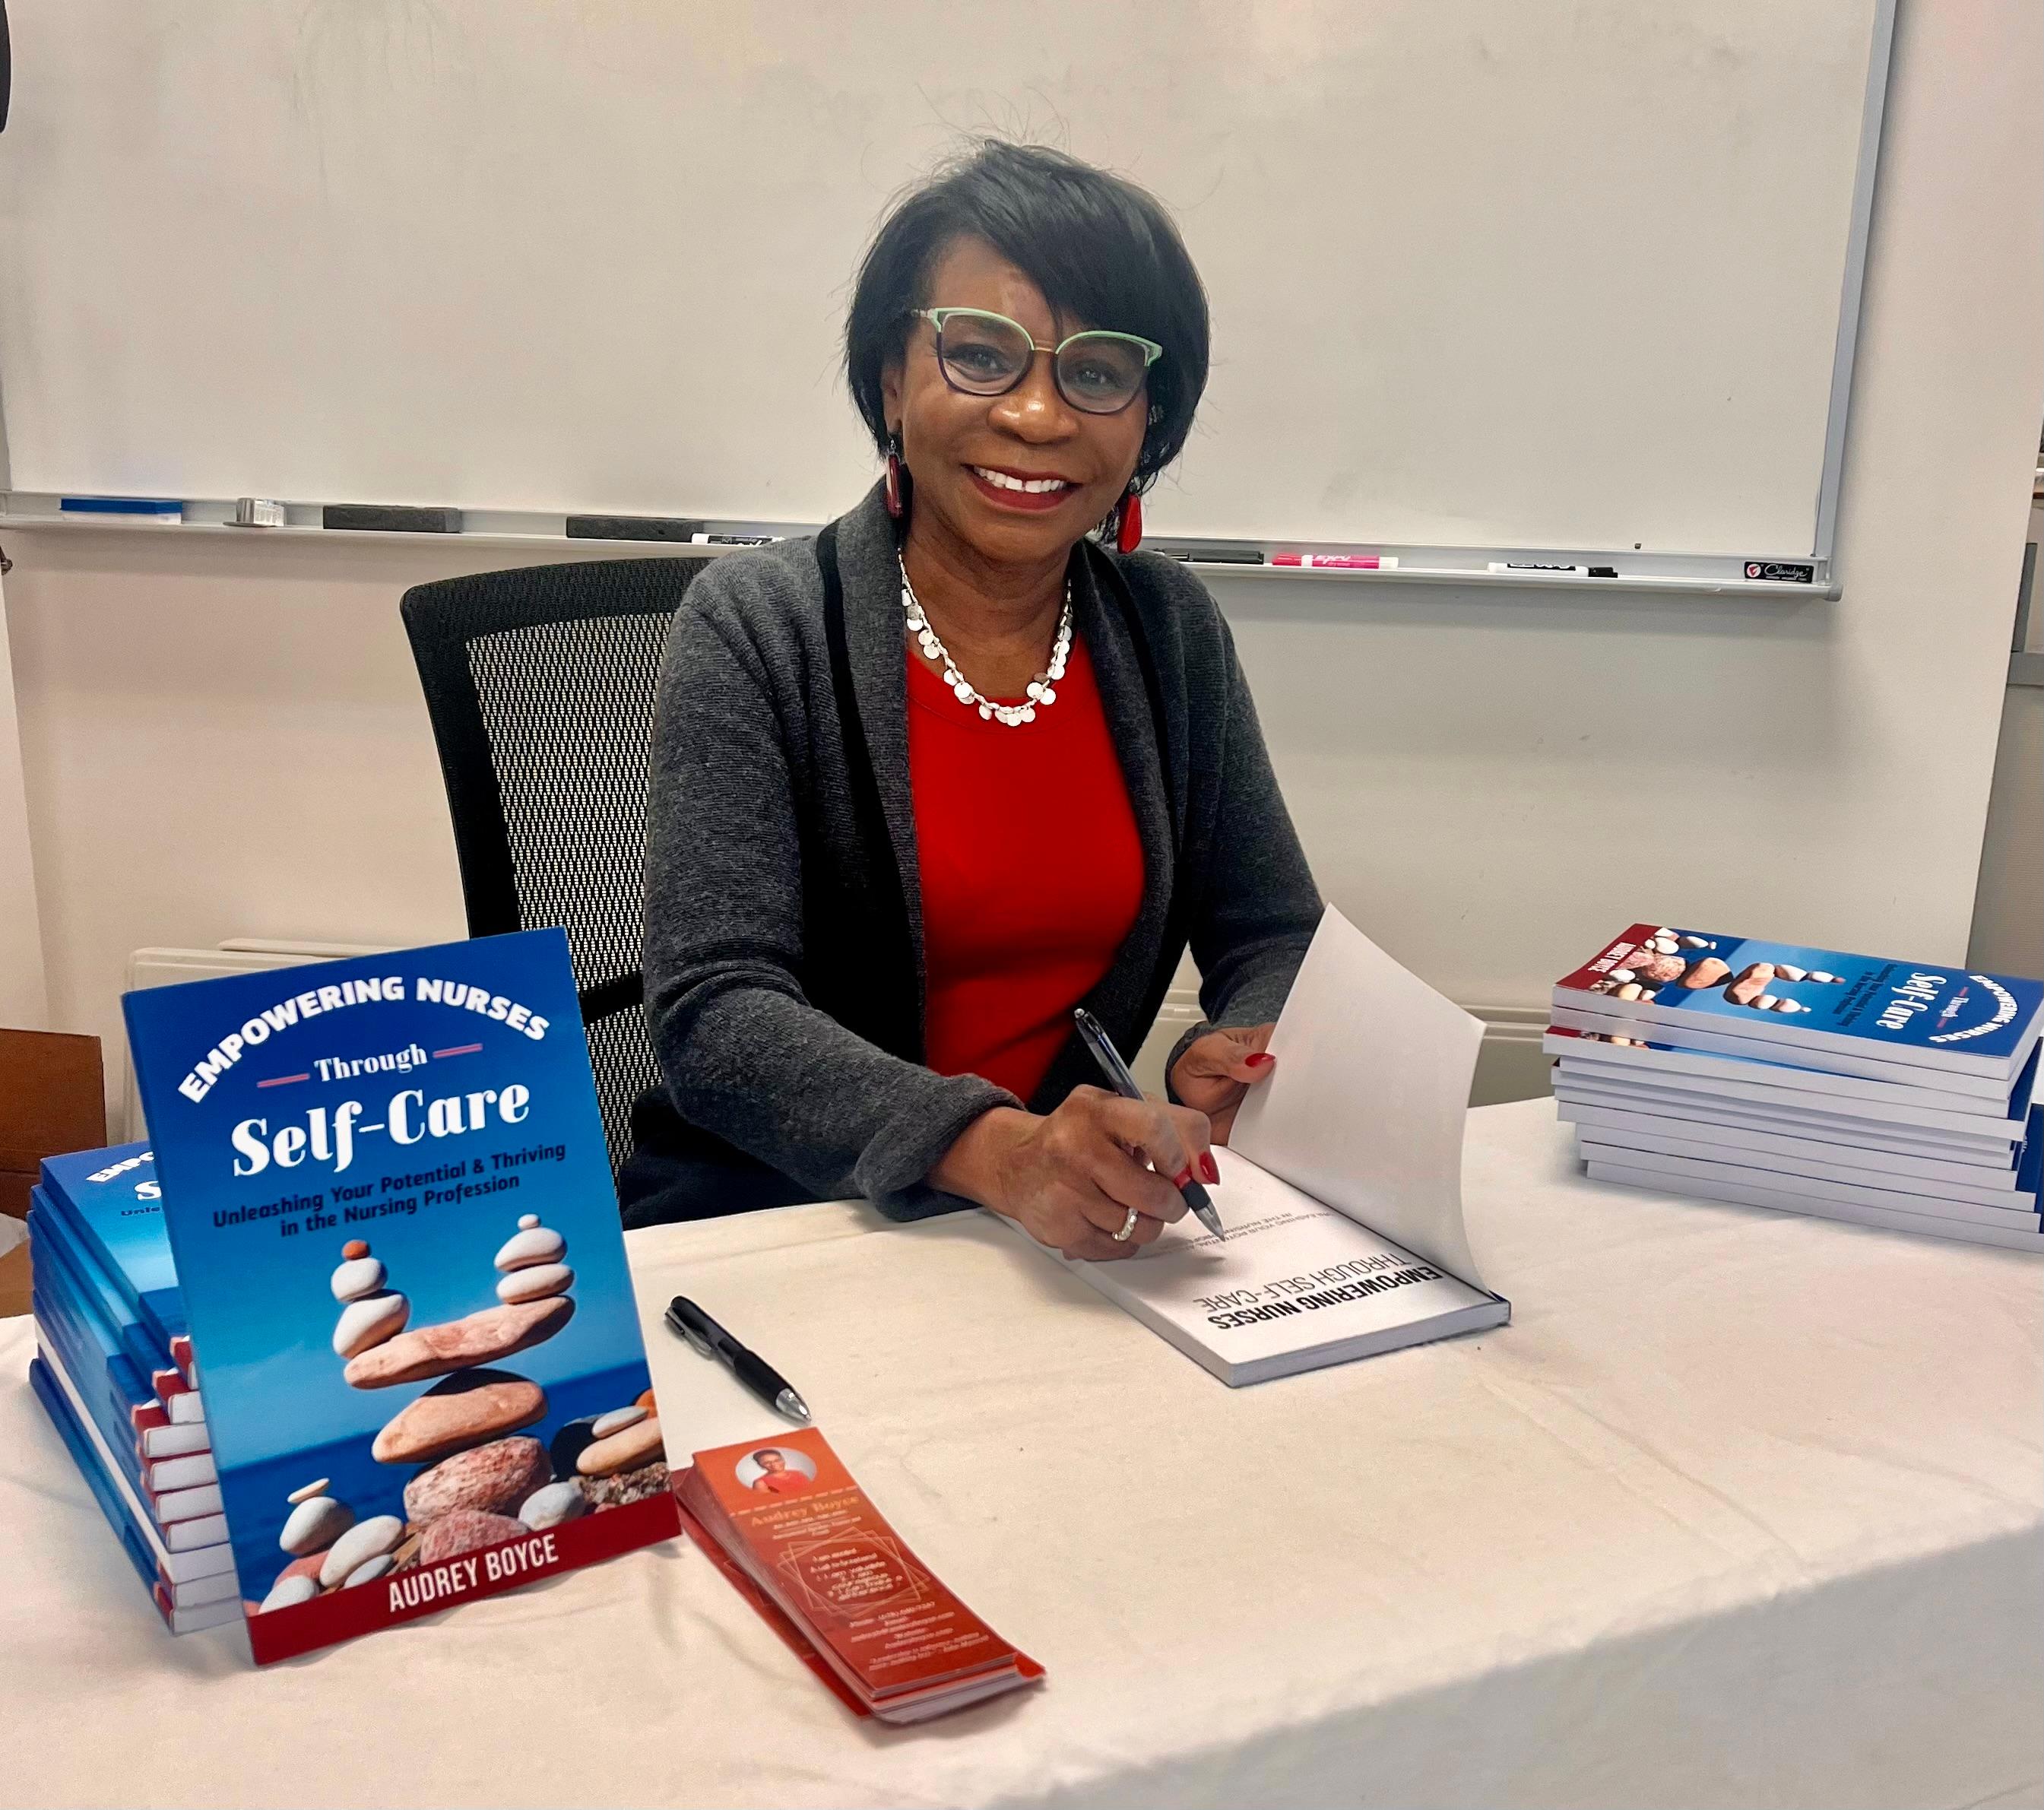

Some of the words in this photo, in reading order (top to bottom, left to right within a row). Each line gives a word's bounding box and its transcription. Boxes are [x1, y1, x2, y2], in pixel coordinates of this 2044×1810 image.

[1764, 563, 1808, 581] Claridge
[1875, 972, 1947, 1029] Self-Care
[1969, 975, 2017, 1023] EMPOWERING
[177, 976, 405, 1102] EMPOWERING
[416, 976, 550, 1041] NURSES
[1928, 1022, 2004, 1043] NURSES
[313, 1043, 428, 1082] Through
[230, 1083, 530, 1177] Self-Care
[213, 1193, 324, 1228] Unleashing
[331, 1183, 375, 1203] Your
[380, 1160, 466, 1193] Potential
[472, 1158, 485, 1174] &
[490, 1143, 566, 1171] Thriving
[280, 1219, 299, 1238] in
[306, 1213, 337, 1231] the
[344, 1197, 417, 1224] Nursing
[424, 1175, 520, 1207] Profession
[1296, 1266, 1443, 1310] EMPOWERING
[1309, 1253, 1412, 1286] THROUGH
[1193, 1276, 1316, 1313] SELF-CARE
[1207, 1300, 1302, 1330] NURSES
[388, 1557, 478, 1612] AUDREY
[485, 1533, 559, 1582] BOYCE
